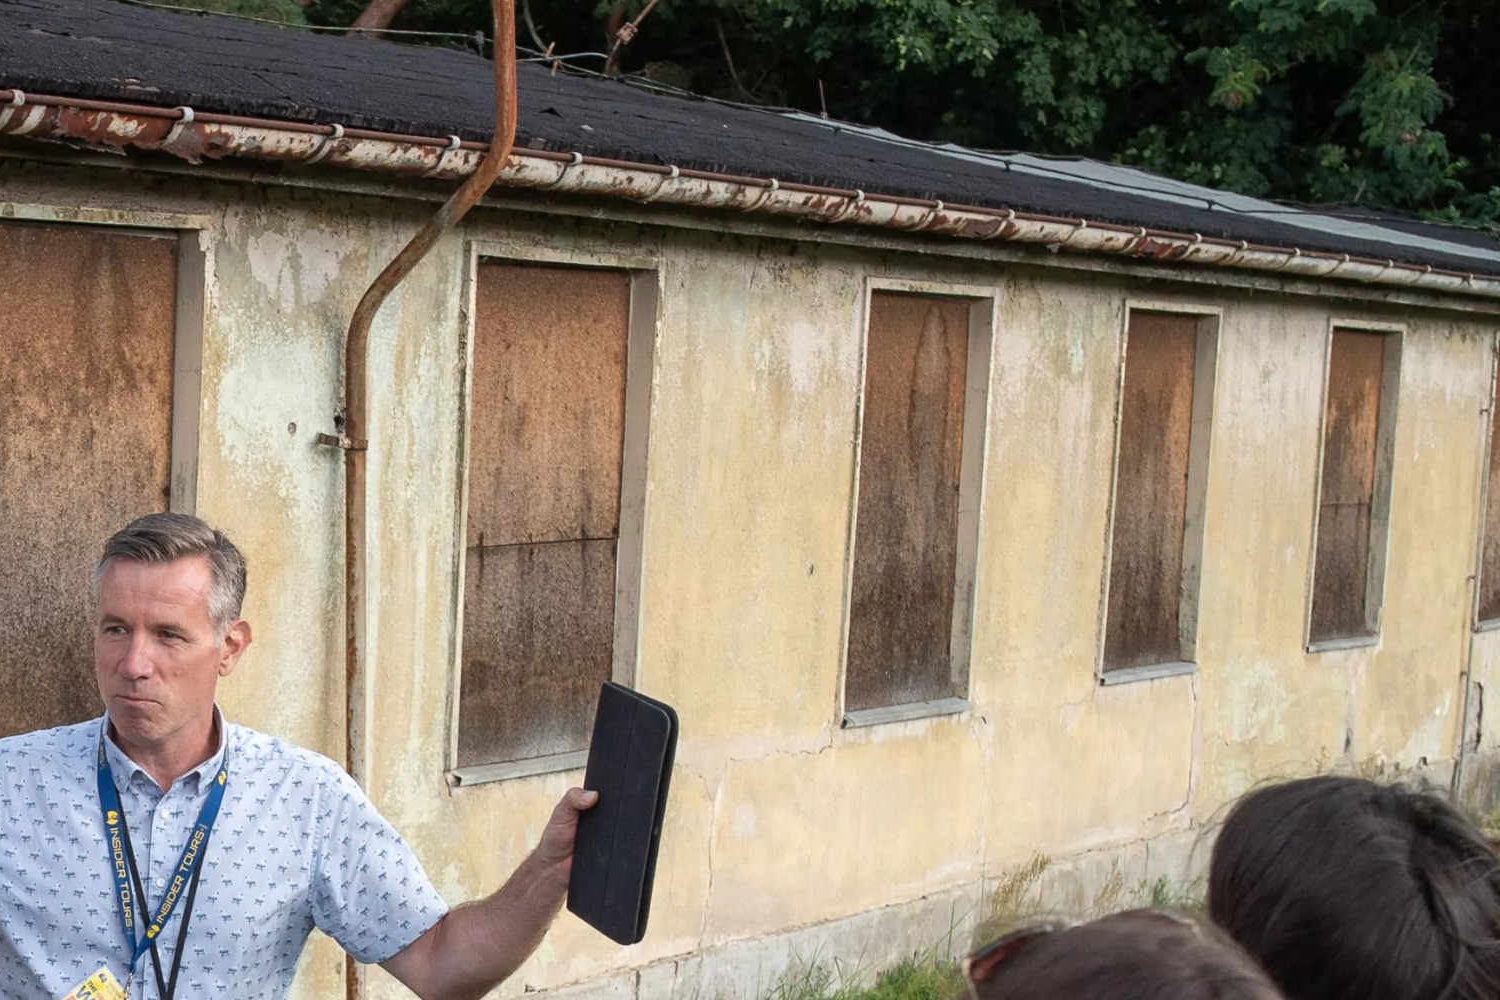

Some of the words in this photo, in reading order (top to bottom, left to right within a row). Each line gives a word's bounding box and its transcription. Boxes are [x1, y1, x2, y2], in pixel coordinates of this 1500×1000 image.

[109, 827, 127, 878] INSIDER
[120, 881, 133, 927] TOURS
[156, 875, 185, 924] INSIDER
[179, 830, 205, 872] TOURS
[87, 980, 98, 993] THE
